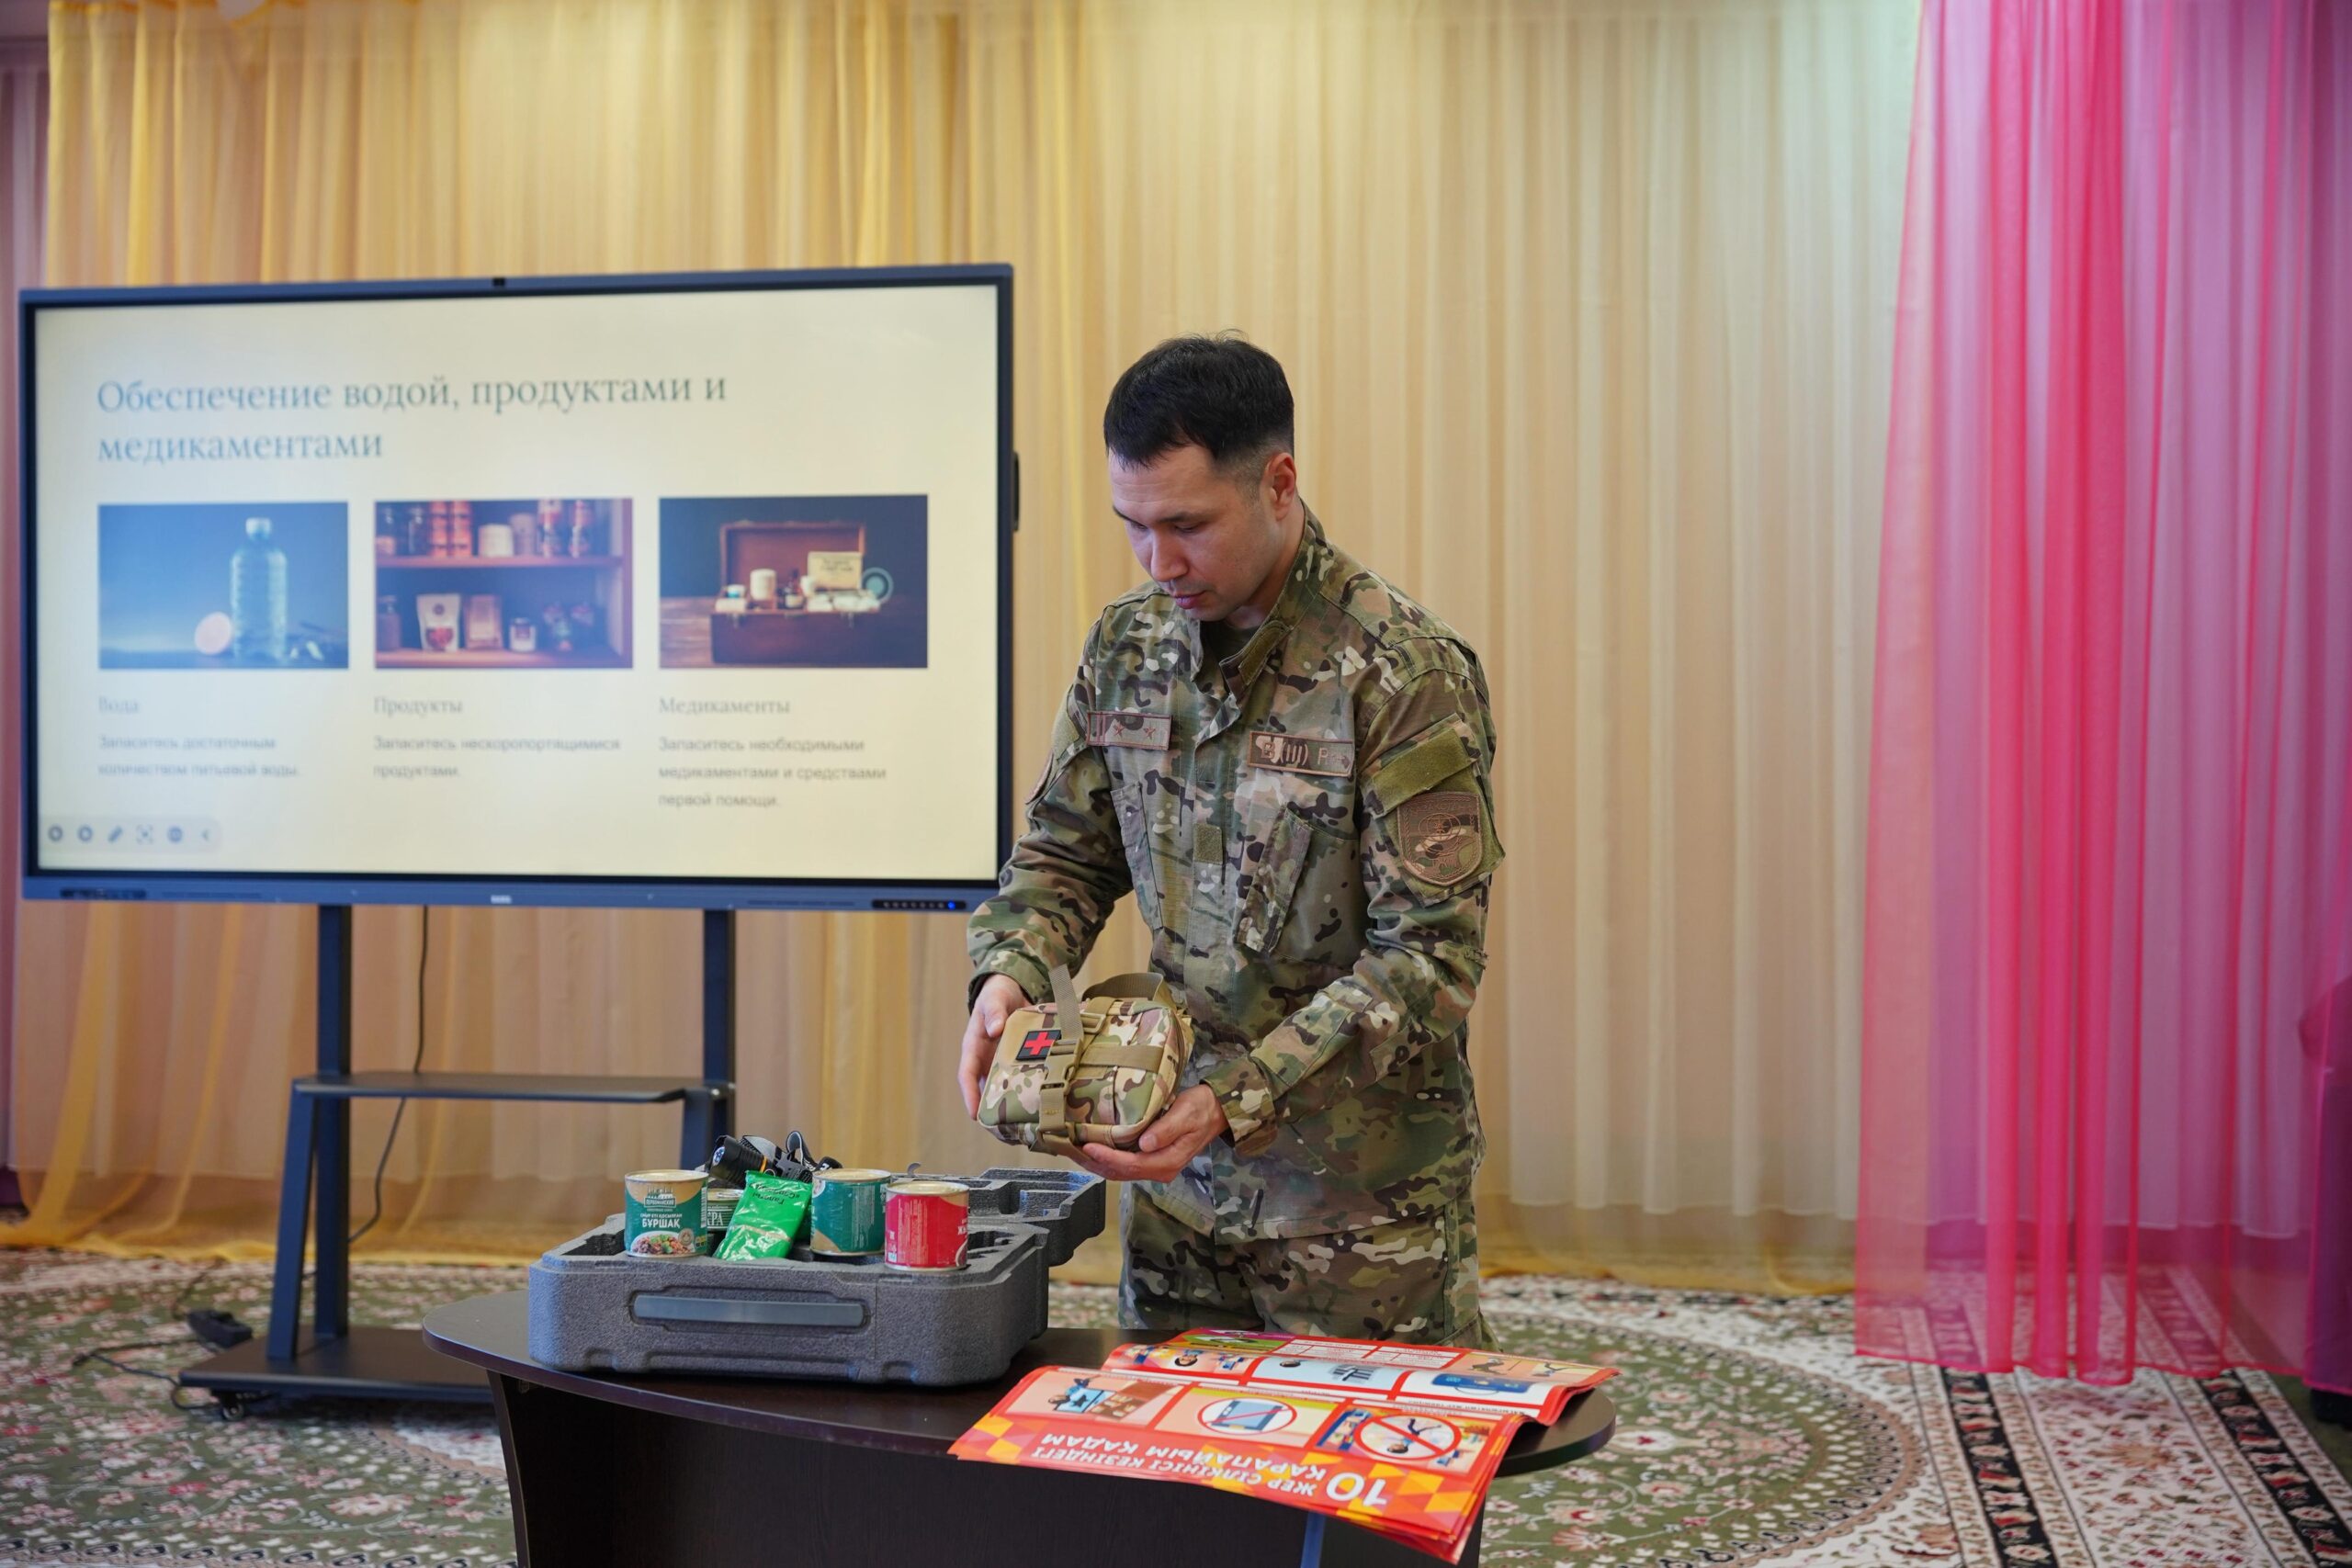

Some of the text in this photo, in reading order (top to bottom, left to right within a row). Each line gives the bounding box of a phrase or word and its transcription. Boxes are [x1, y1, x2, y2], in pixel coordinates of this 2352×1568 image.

[96, 376, 728, 415] Обеспечение водой, продуктами и
[98, 433, 383, 465] медикаментами
[97, 696, 141, 715] Вода
[373, 696, 464, 719] Продукты
[658, 696, 791, 716] Медикаменты
[98, 735, 277, 752] Запаситесь достаточным
[373, 734, 457, 752] Запаситесь
[658, 735, 865, 754] Запаситесь необходимыми
[97, 763, 187, 779] количеством
[191, 762, 257, 779] питьевой
[658, 765, 888, 784] медикаментами и средствами
[657, 792, 712, 810] первой
[641, 1218, 681, 1229] БҰРШАҚ
[1030, 1446, 1318, 1497] ЖЕР СІЛКІНІСІ КЕЗІНДЕГІ
[1326, 1472, 1388, 1507] 10
